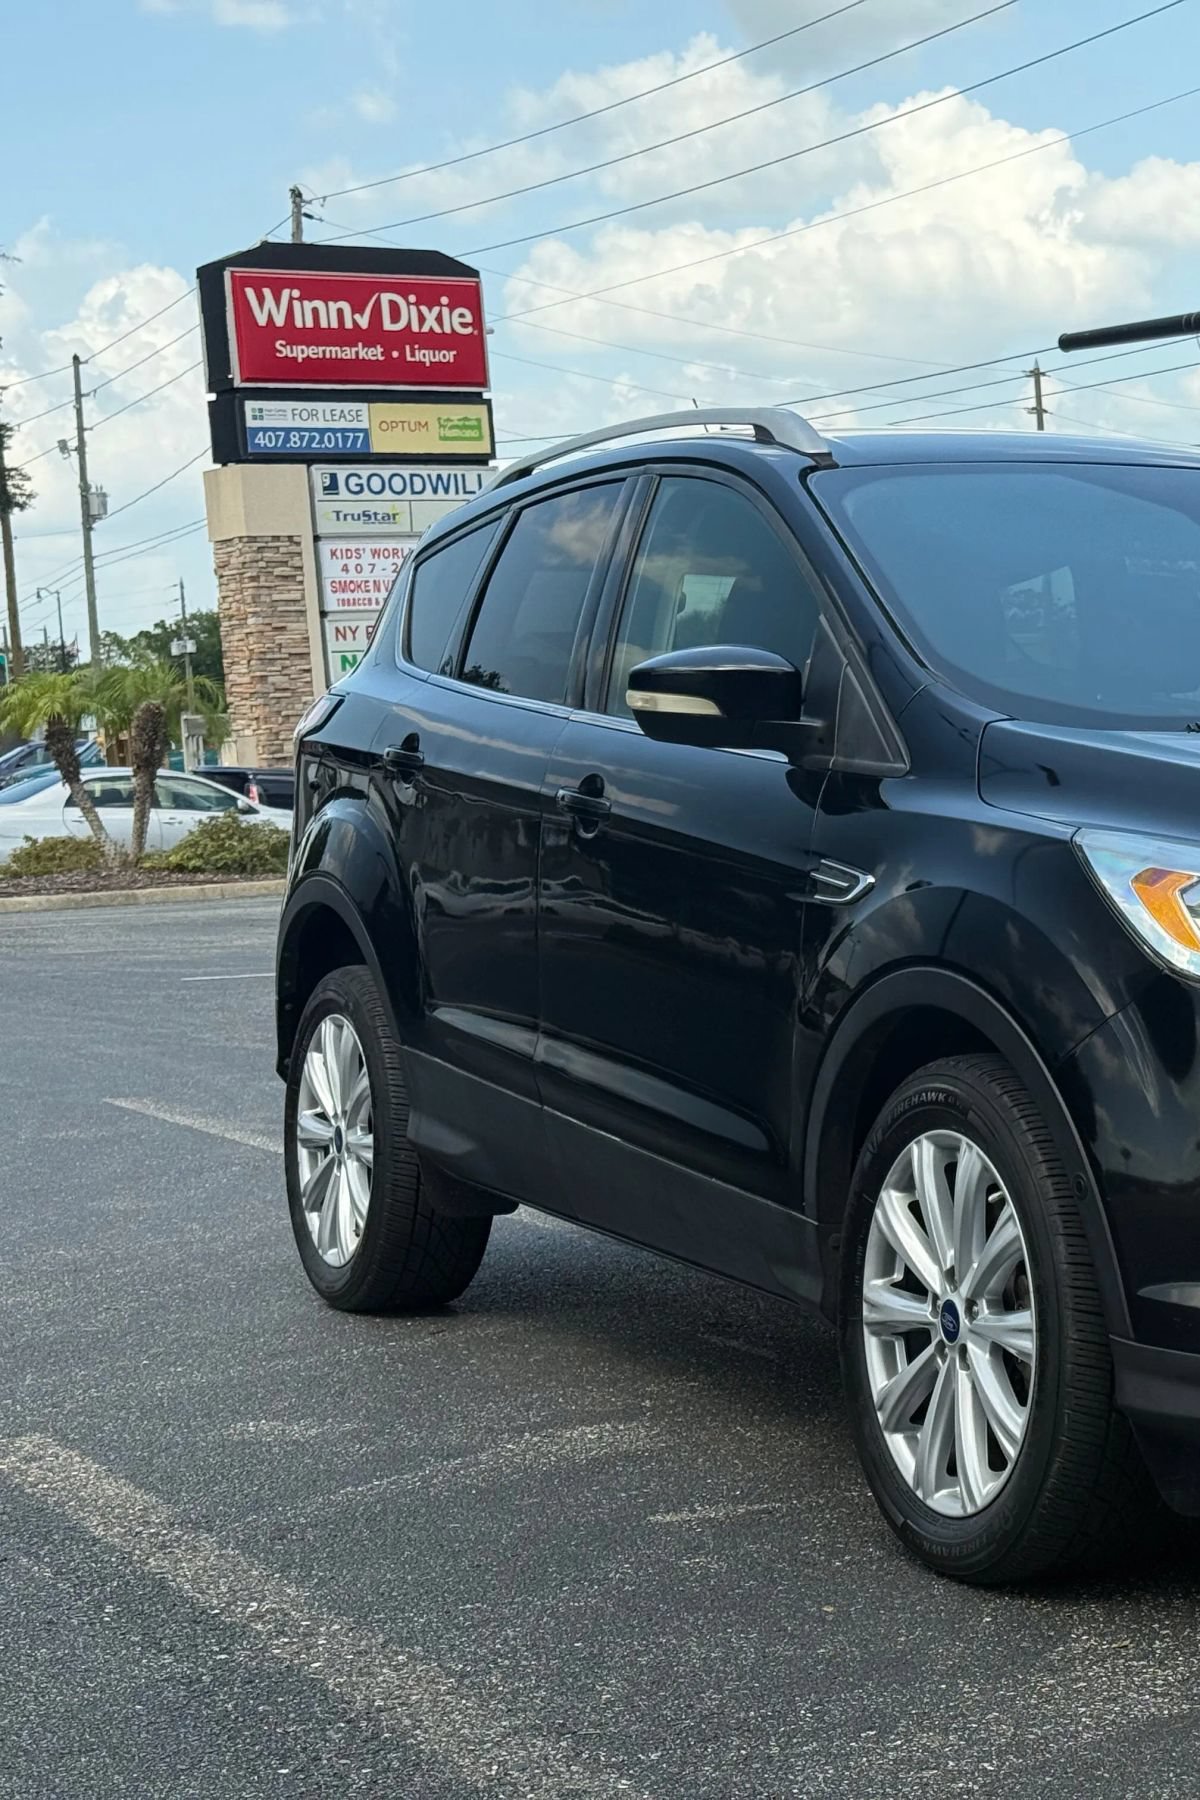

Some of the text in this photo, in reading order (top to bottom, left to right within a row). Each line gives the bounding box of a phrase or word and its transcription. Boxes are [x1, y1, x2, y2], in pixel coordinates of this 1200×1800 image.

[244, 287, 475, 335] Winn Dixie
[274, 340, 457, 367] Supermarket Liquor
[291, 408, 319, 422] FOR
[322, 408, 364, 423] LEASE
[378, 420, 429, 433] OPTUM
[254, 431, 365, 449] 407.872.0177
[331, 510, 400, 522] TruStar
[330, 547, 366, 560] KIDS'
[330, 579, 371, 594] SMOKE
[373, 579, 381, 593] N
[335, 625, 359, 642] NY
